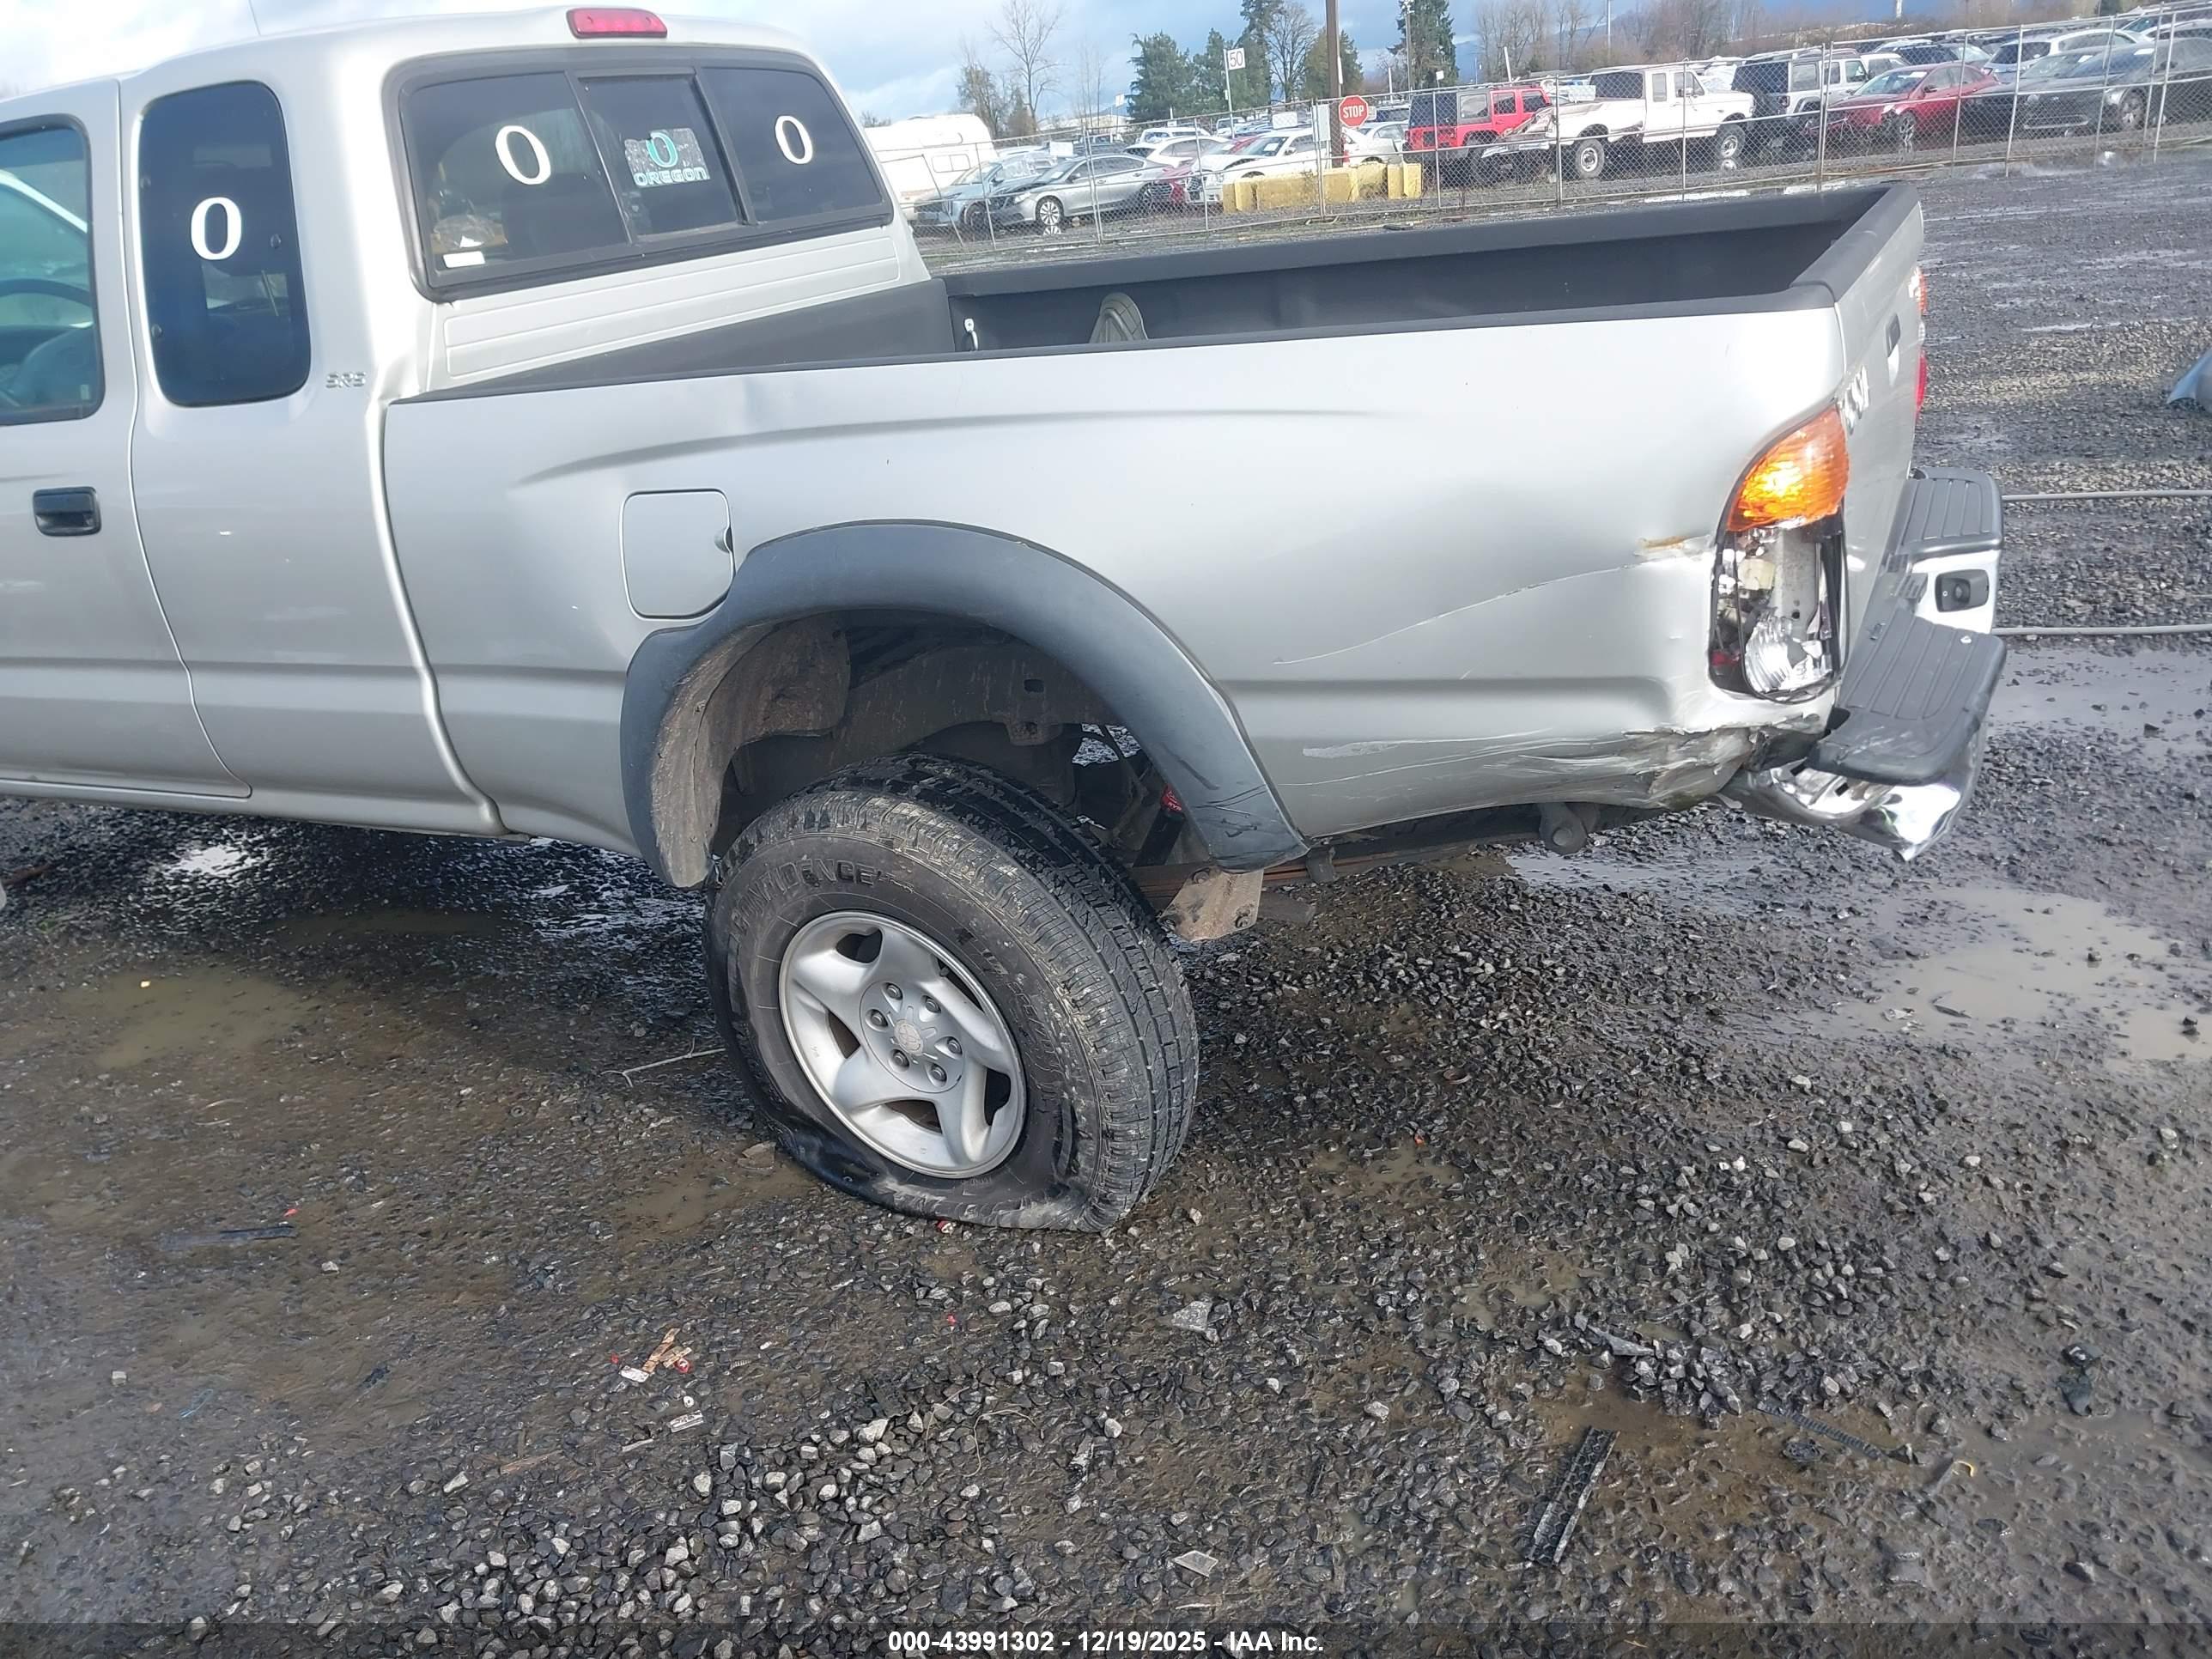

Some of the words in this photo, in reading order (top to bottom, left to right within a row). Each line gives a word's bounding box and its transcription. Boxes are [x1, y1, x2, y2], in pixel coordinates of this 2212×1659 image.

[1230, 51, 1243, 67] 50
[1342, 105, 1364, 118] STOP
[633, 167, 708, 186] OREGON
